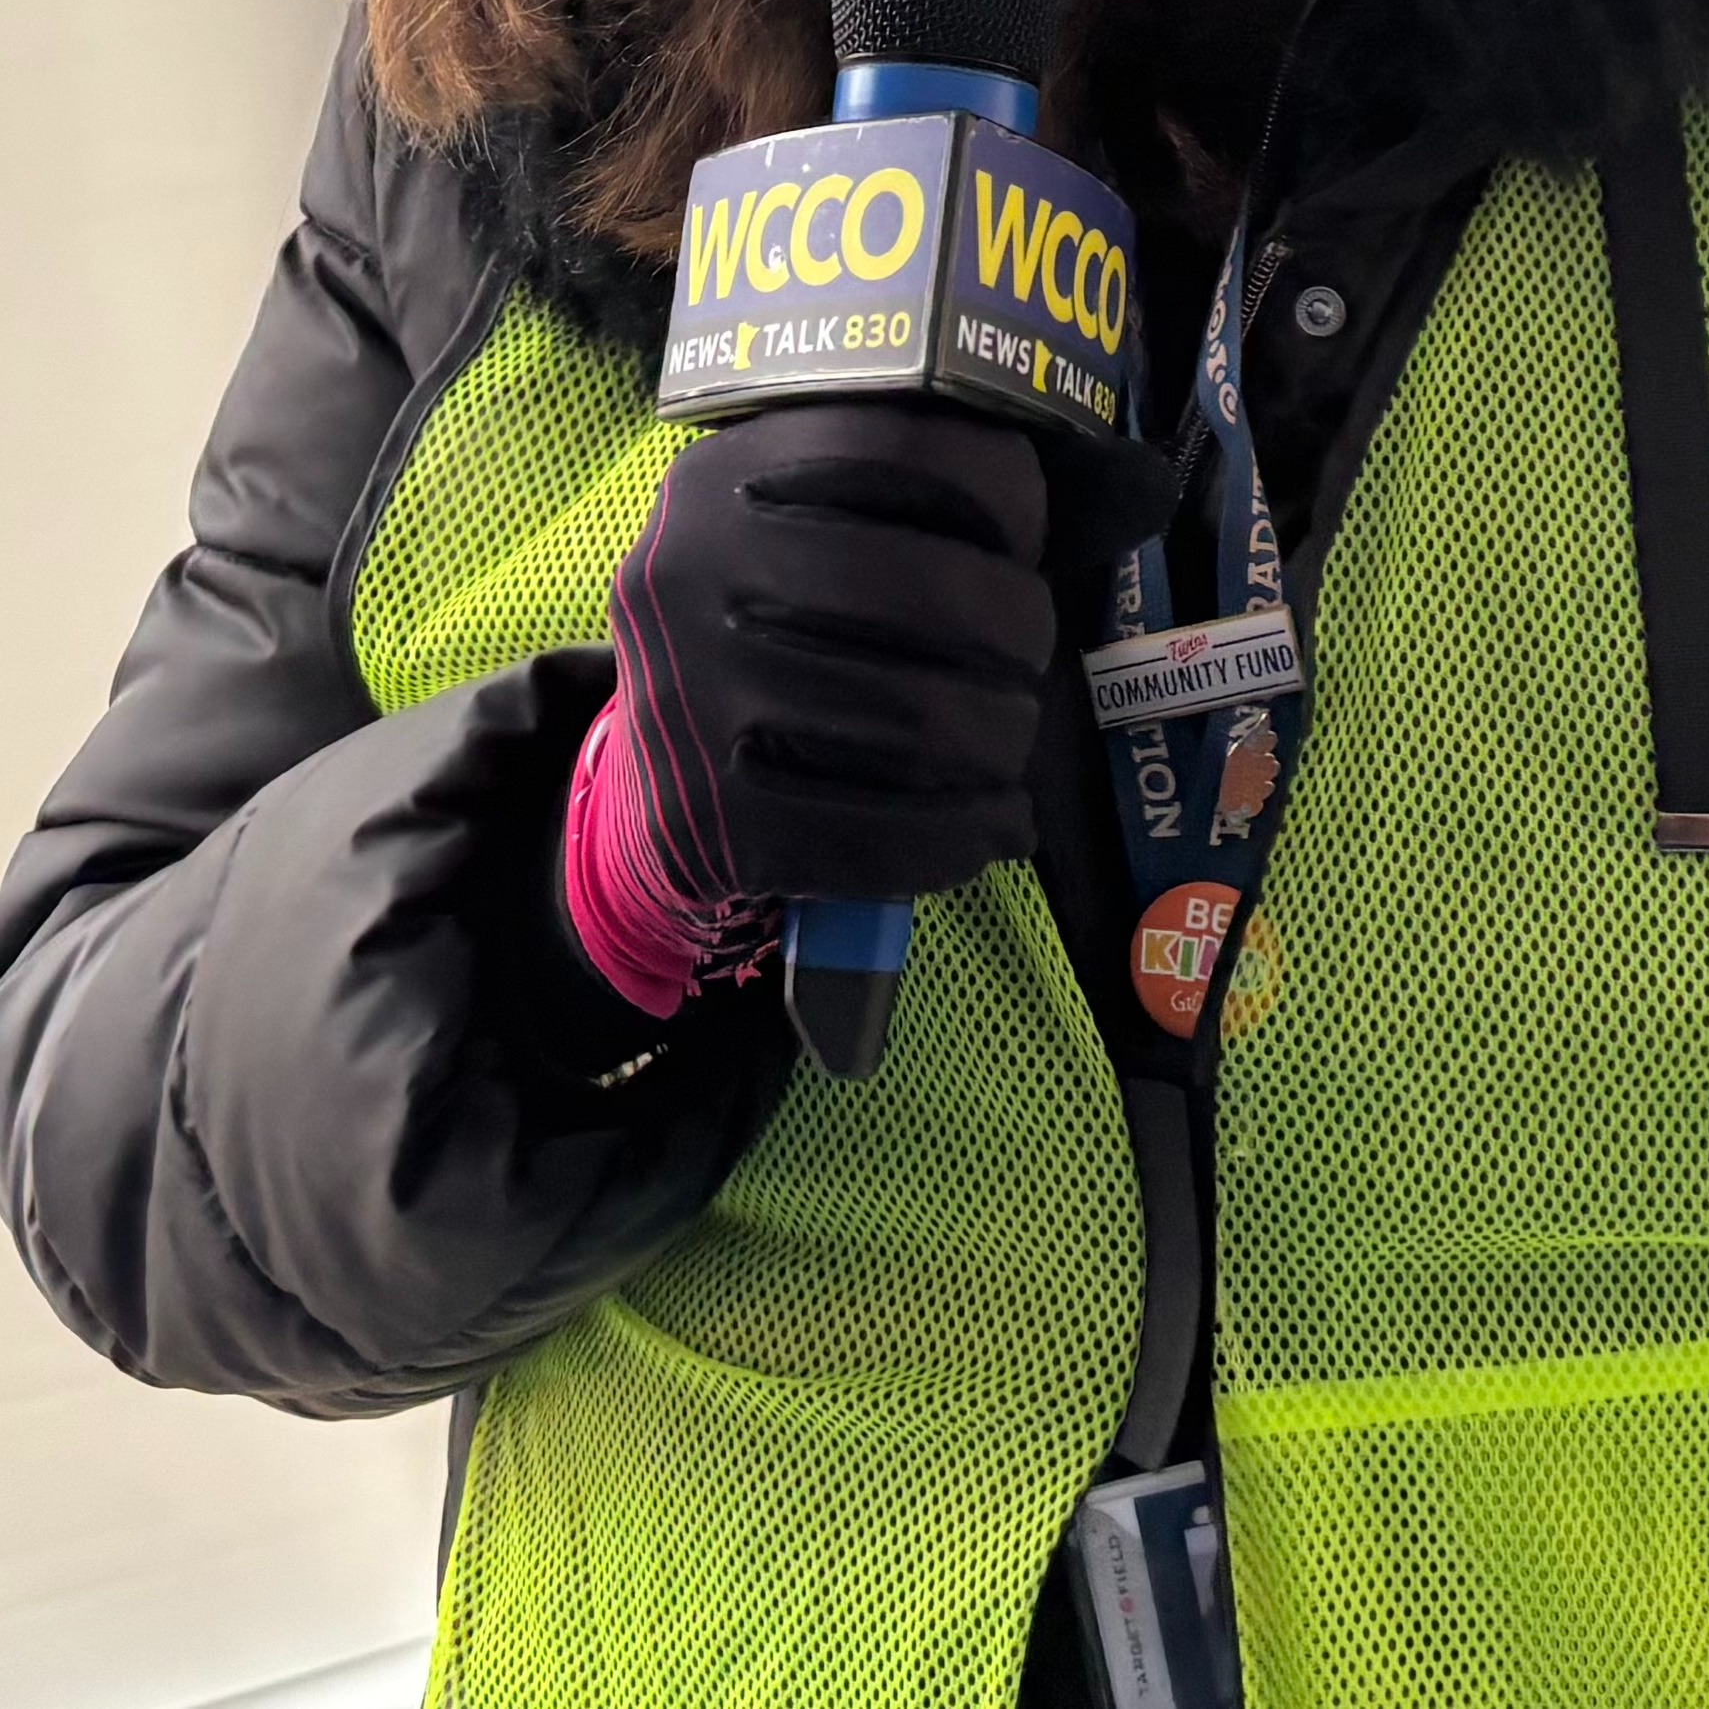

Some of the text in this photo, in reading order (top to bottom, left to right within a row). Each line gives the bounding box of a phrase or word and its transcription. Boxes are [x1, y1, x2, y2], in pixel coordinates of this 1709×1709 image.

[687, 167, 926, 307] WCCO
[974, 168, 1129, 357] WCCO
[667, 311, 911, 376] NEWS TALK 830
[957, 313, 1033, 378] NEWS
[1054, 355, 1095, 410] TALK
[1096, 644, 1295, 711] COMMUNITY FUND
[1185, 897, 1235, 933] BE
[1107, 1533, 1151, 1699] TARGET FIELD
